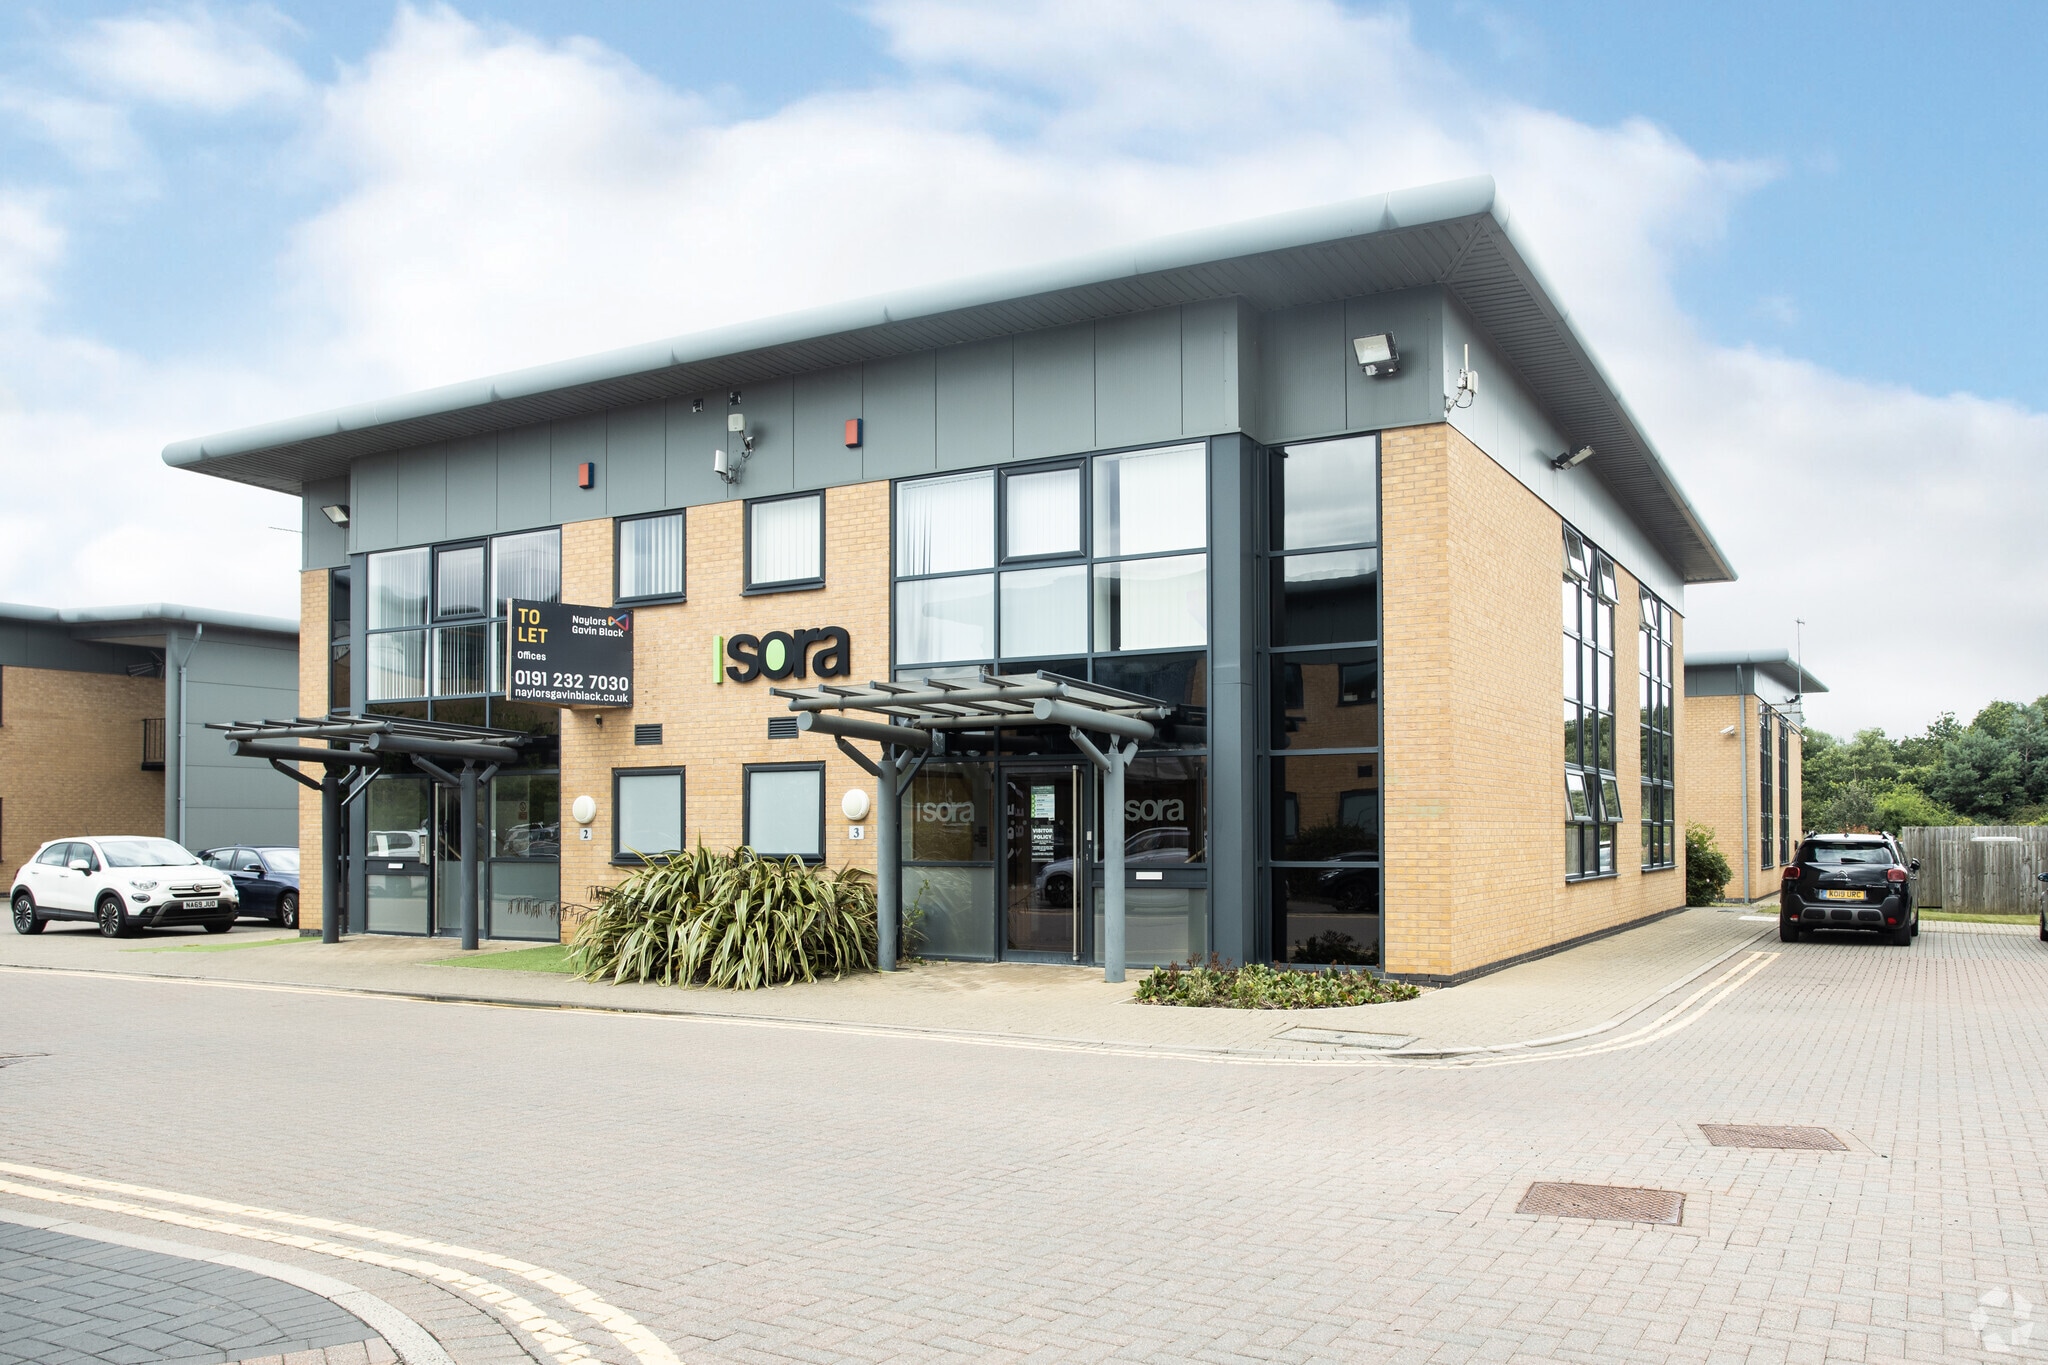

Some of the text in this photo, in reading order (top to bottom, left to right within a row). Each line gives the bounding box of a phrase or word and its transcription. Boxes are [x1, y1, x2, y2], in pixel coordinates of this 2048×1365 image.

[518, 608, 540, 625] TO
[572, 615, 607, 626] Naylors
[518, 626, 548, 644] LET
[571, 625, 624, 638] Gavin Black
[517, 650, 547, 661] Offices
[515, 669, 629, 692] 0191 232 7030
[515, 688, 629, 703] naylorsgavinblack.co.uk
[583, 829, 589, 839] 2
[853, 827, 860, 839] 3
